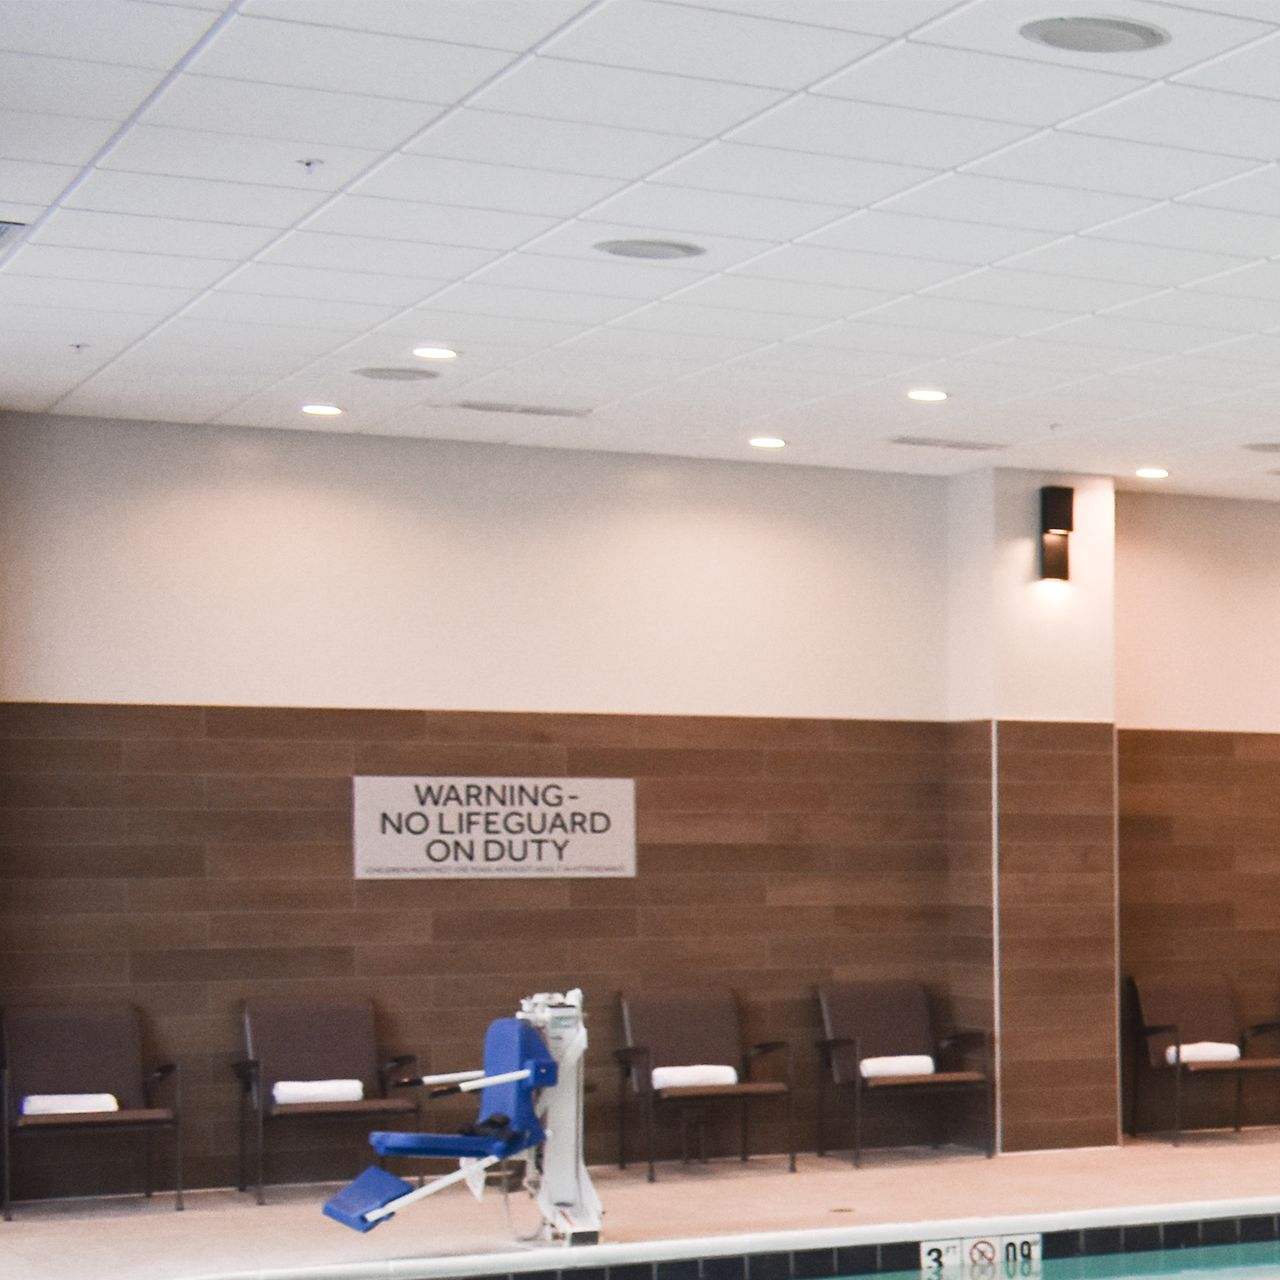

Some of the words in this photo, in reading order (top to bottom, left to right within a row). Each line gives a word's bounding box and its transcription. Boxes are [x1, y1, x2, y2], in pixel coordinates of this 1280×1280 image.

[381, 811, 430, 835] NO
[438, 811, 612, 835] LIFEGUARD
[426, 839, 474, 863] ON
[484, 839, 570, 862] DUTY
